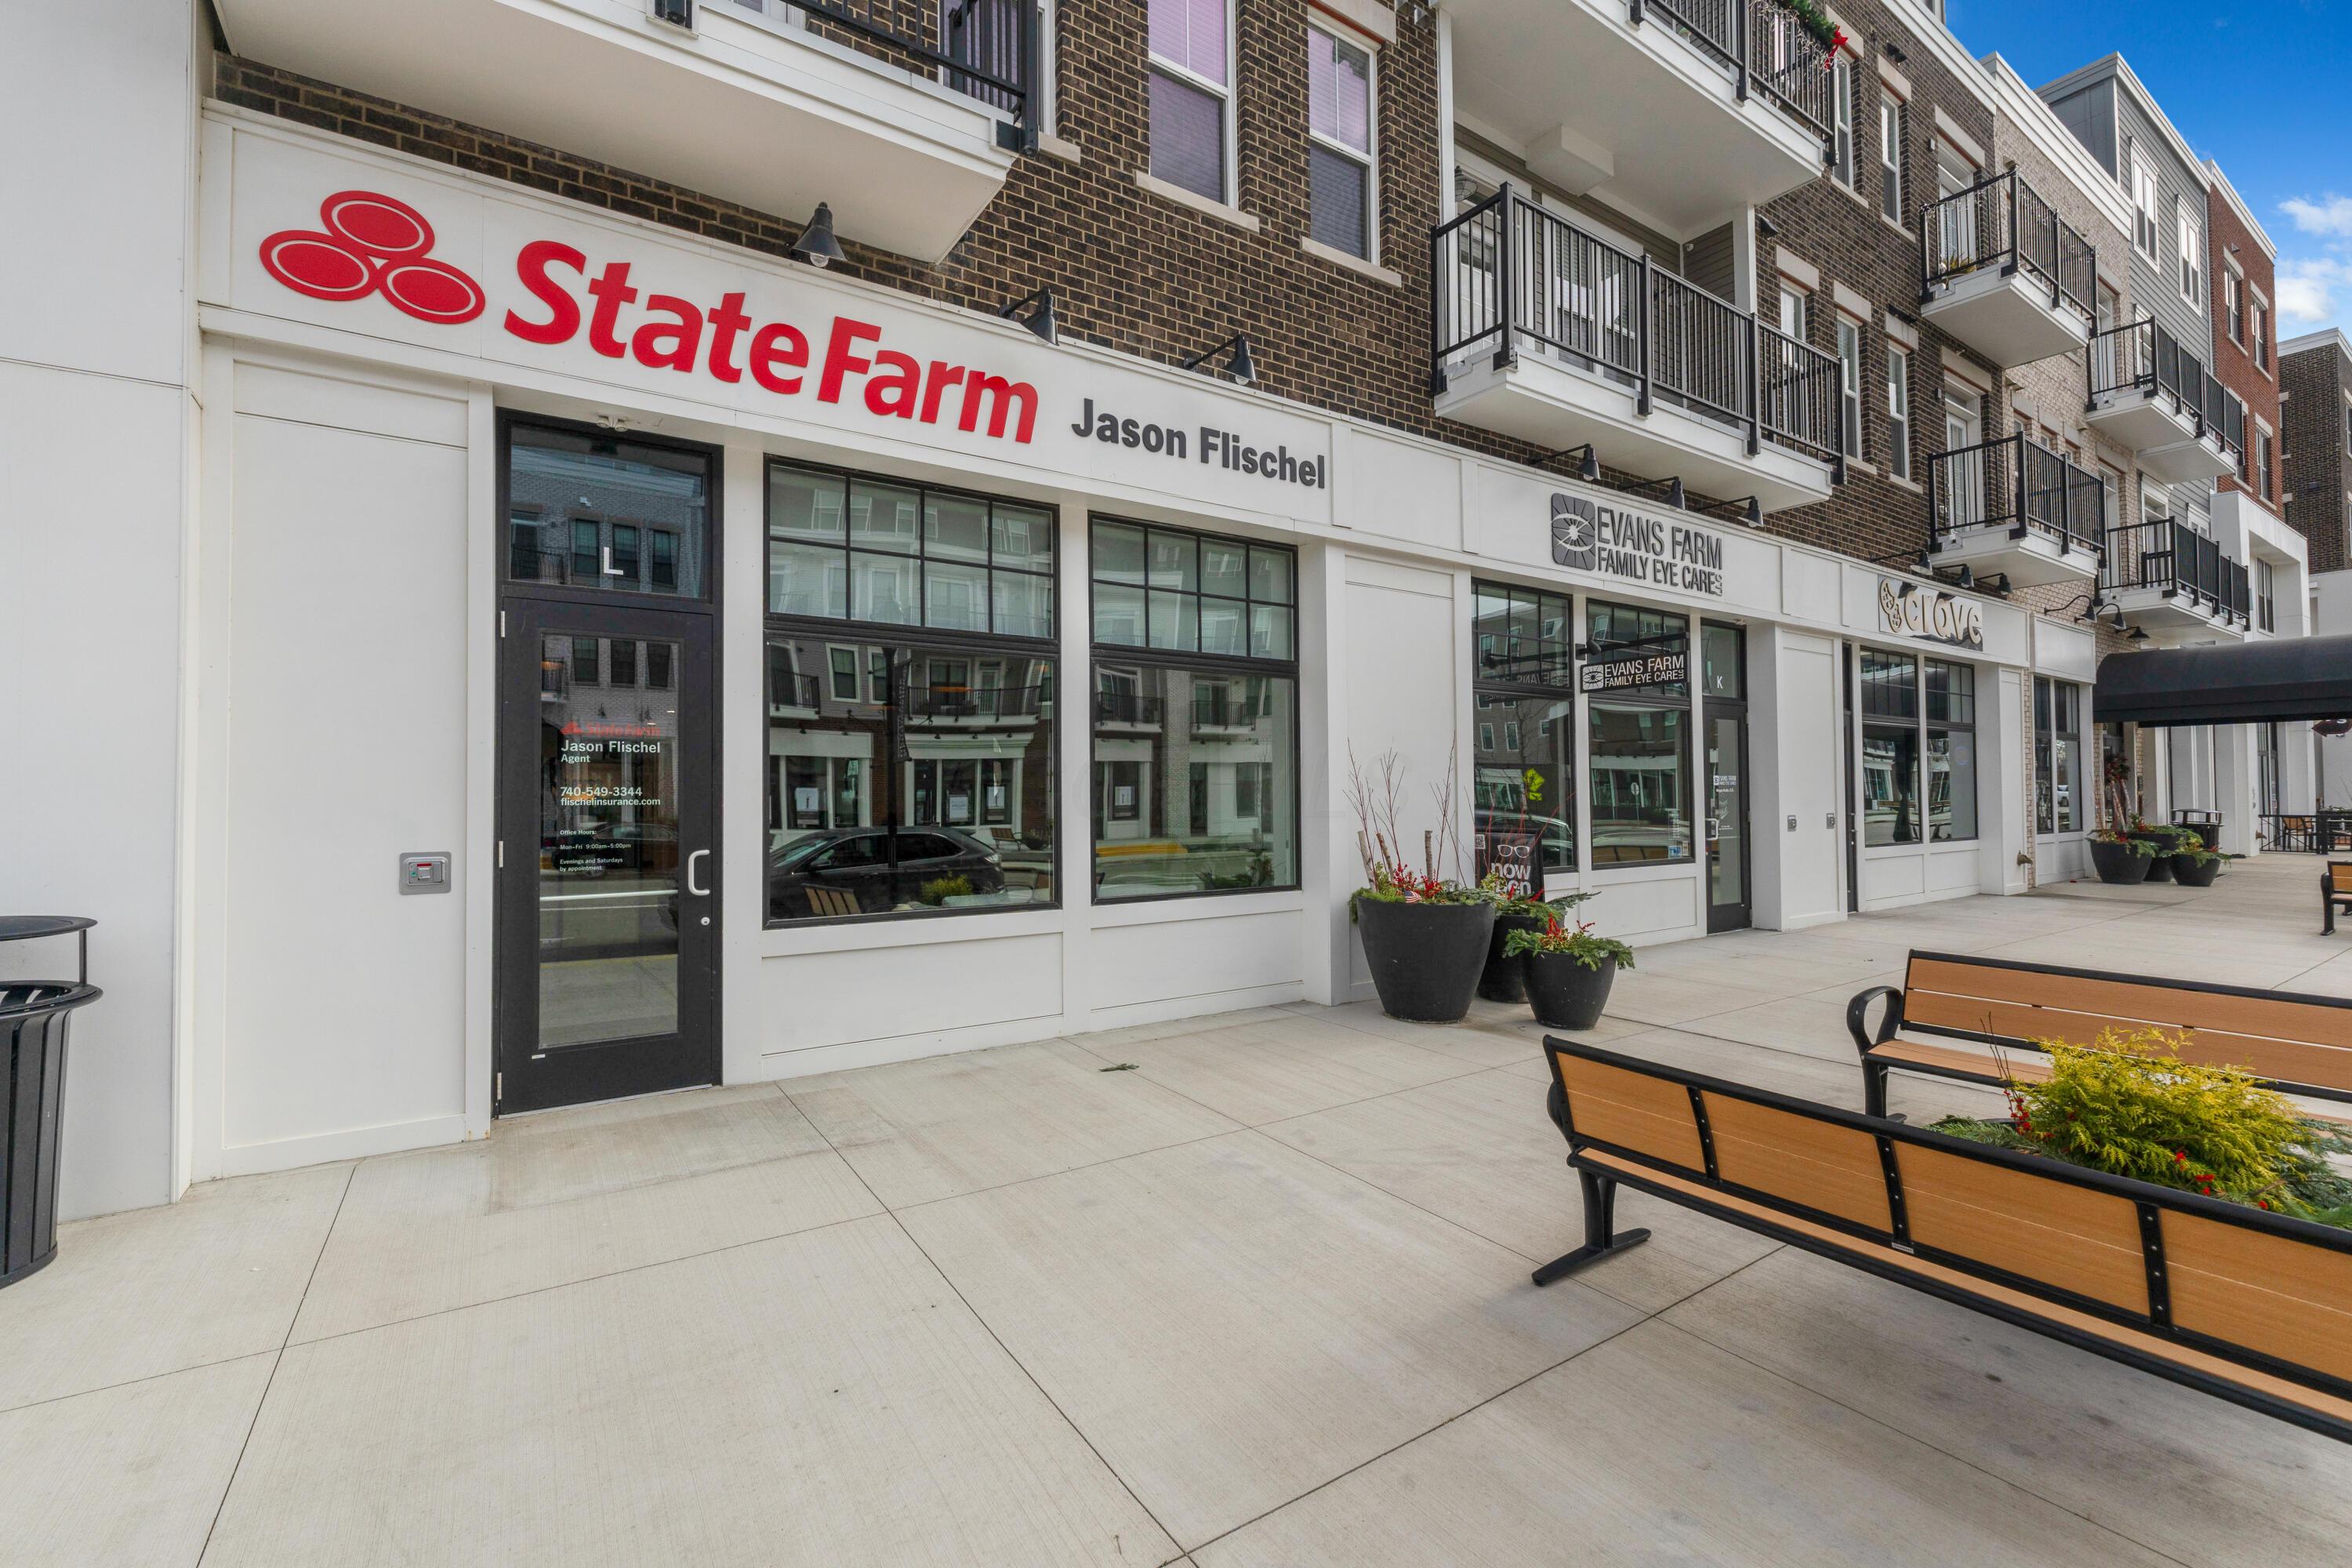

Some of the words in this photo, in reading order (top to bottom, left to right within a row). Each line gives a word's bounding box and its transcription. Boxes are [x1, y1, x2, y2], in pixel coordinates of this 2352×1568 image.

[1071, 397, 1187, 459] Jason
[1200, 426, 1325, 490] Flischel
[1598, 506, 1665, 557] EVANS
[1671, 525, 1723, 571] FARM
[604, 546, 624, 575] L
[1598, 546, 1649, 580] FAMILY
[1653, 559, 1679, 586] EYE
[1682, 565, 1716, 594] CARE
[1604, 660, 1643, 677] EVANS
[1648, 655, 1684, 673] FARM
[1605, 675, 1633, 688] FAMILY
[1635, 673, 1652, 684] EYE
[1654, 670, 1679, 682] CARE
[1717, 676, 1723, 689] K
[561, 739, 604, 752] Jason
[608, 740, 661, 753] Flischel
[561, 753, 590, 764] Agent
[560, 786, 643, 797] 740-549-3344
[561, 797, 661, 806] flischelinsurance.com
[1490, 862, 1531, 880] now
